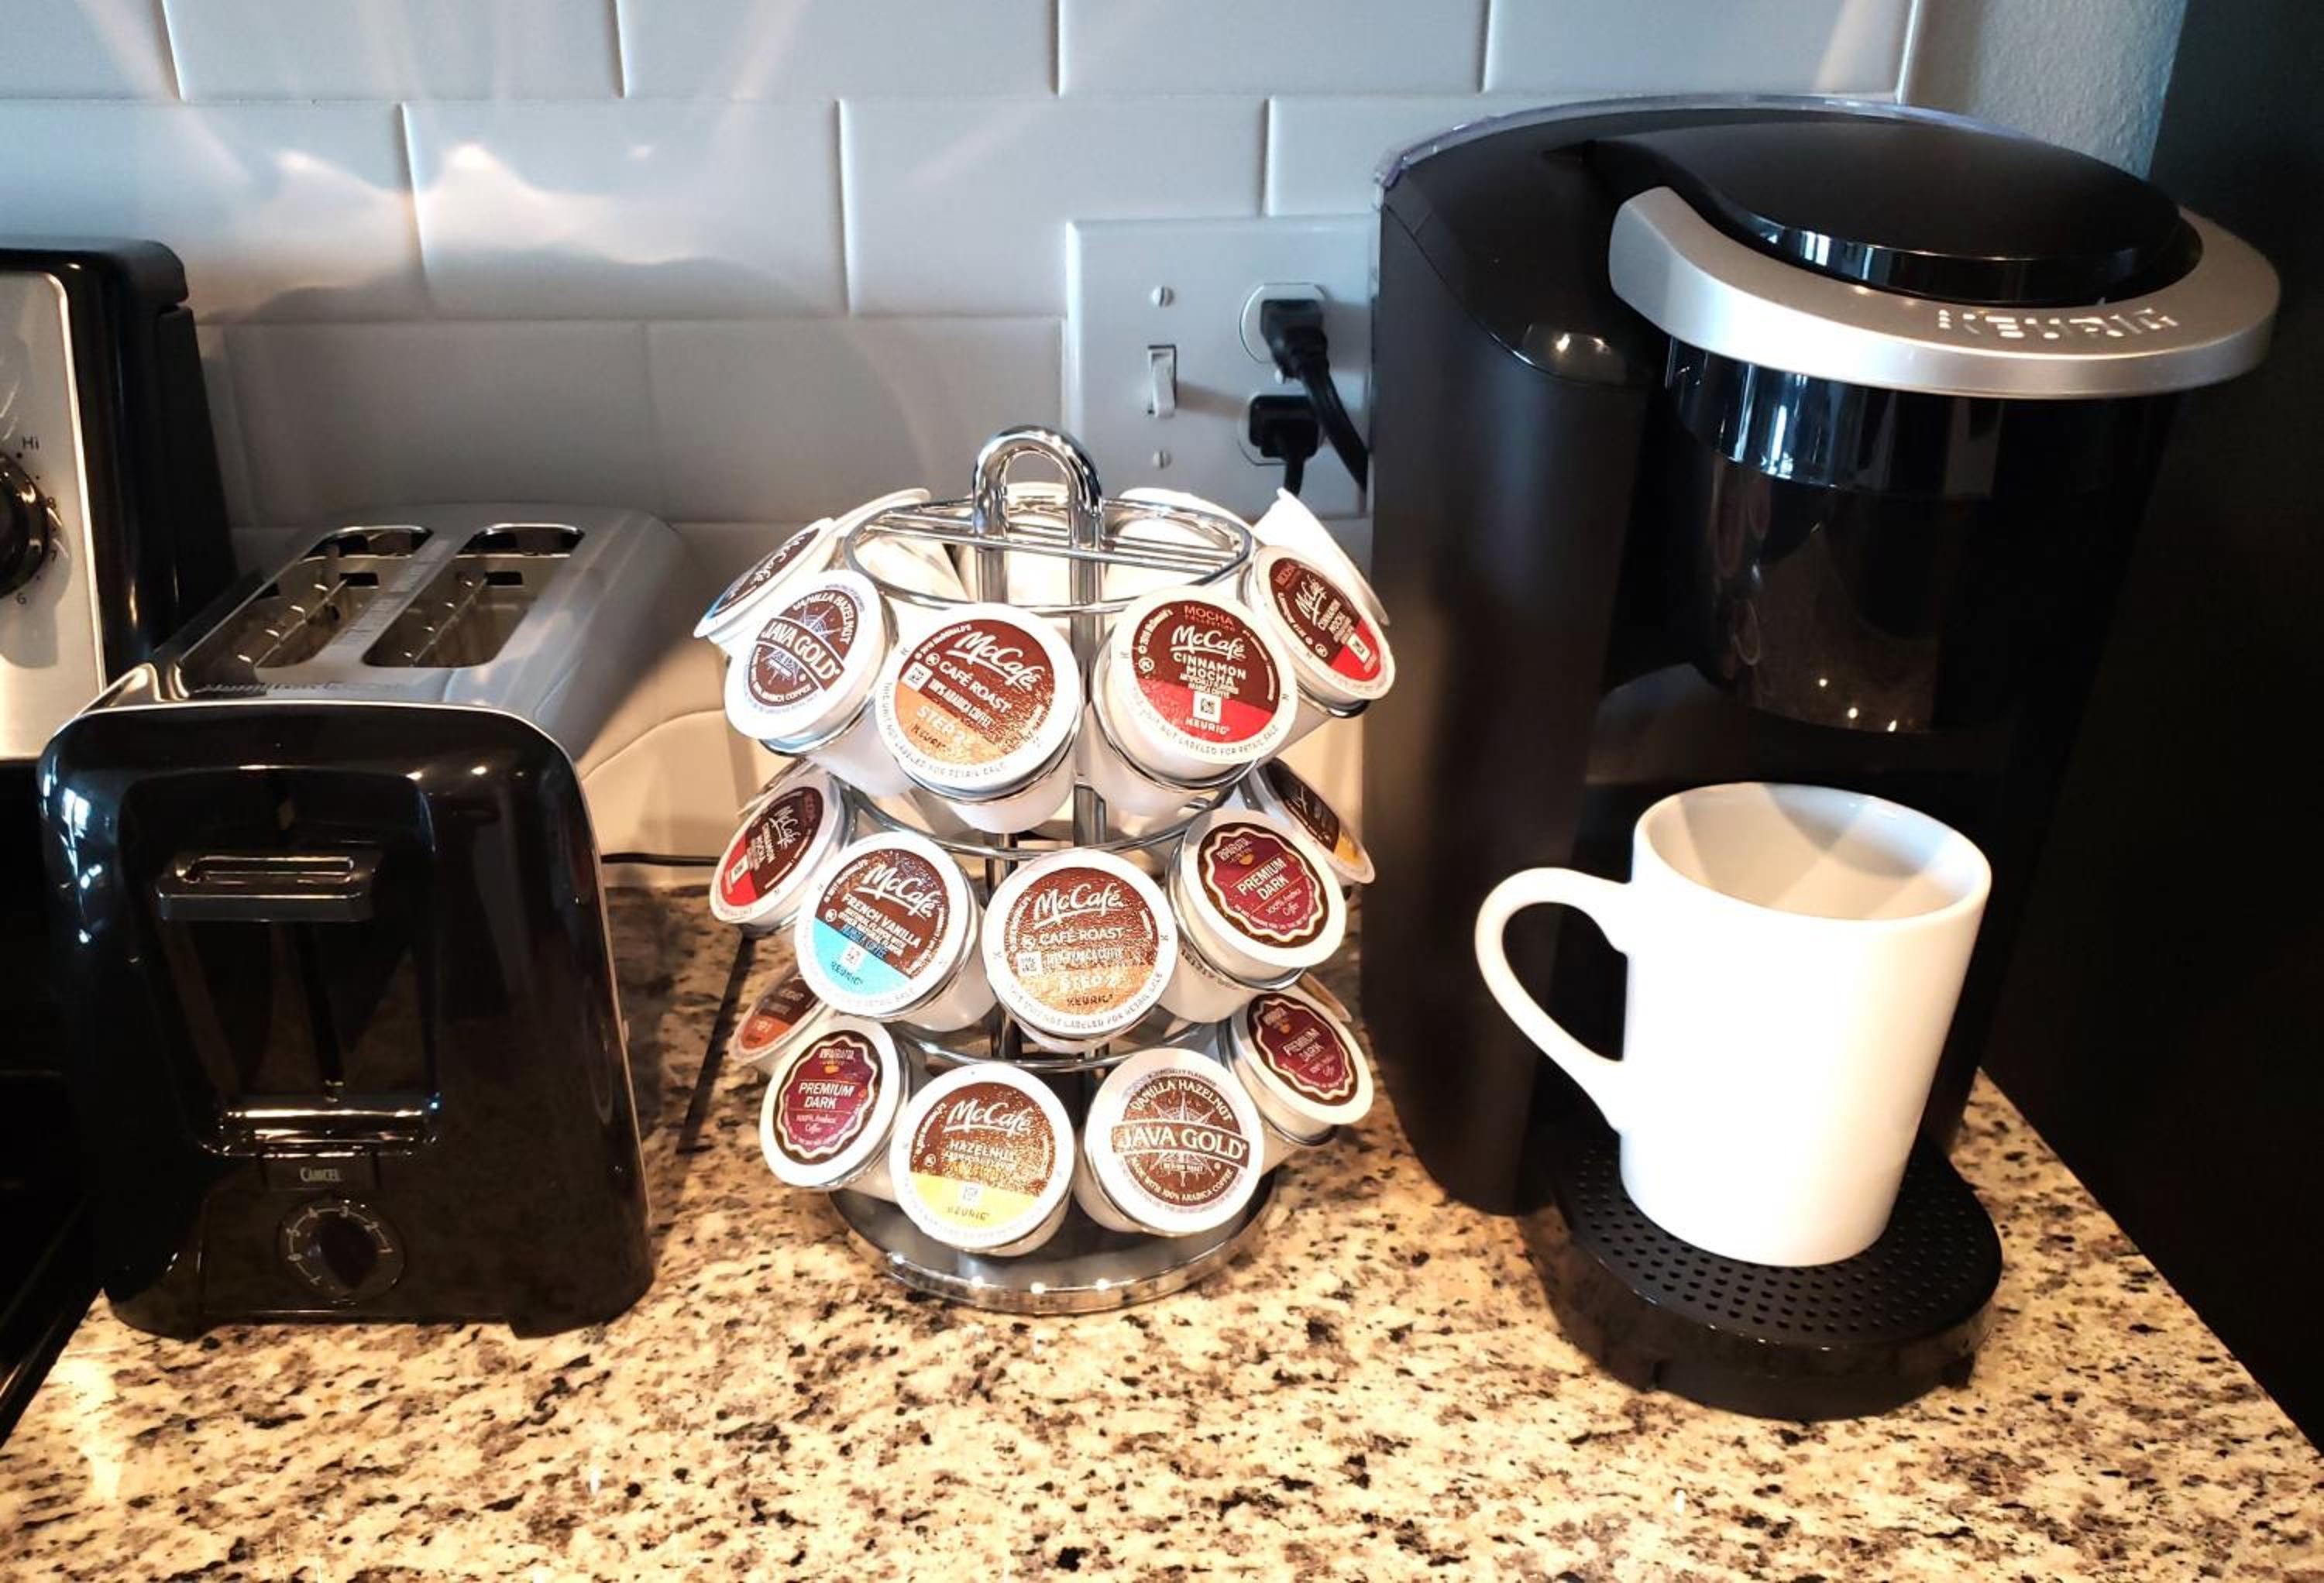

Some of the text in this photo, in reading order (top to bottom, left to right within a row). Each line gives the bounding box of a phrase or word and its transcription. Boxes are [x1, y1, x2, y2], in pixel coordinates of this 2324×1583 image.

[22, 437, 39, 449] Hi
[16, 592, 27, 606] 6
[1184, 605, 1234, 627] MOCHA
[760, 621, 798, 648] JAVA
[794, 635, 837, 679] GOLD
[1171, 625, 1247, 661] McCafé
[946, 631, 1046, 693] McCafé
[1173, 652, 1246, 680] CINNAMON
[1186, 665, 1235, 687] MOCHA
[939, 661, 1013, 713] CAFÉ ROAST
[1185, 717, 1229, 735] KEURIG
[1236, 857, 1287, 896] PREMIUM
[1256, 874, 1290, 901] DARK
[854, 863, 942, 922] McCafé
[1033, 882, 1126, 930] McCafé
[841, 892, 882, 923] FRENCH
[881, 915, 922, 949] VANILLA
[1040, 927, 1124, 945] CAFÉ ROAST
[798, 1082, 855, 1097] PREMIUM
[803, 1096, 837, 1110] DARK
[1177, 1079, 1233, 1122] HAZELNUT
[942, 1097, 1035, 1138] McCafé
[947, 1138, 1016, 1161] HAZELNUT
[1116, 1125, 1244, 1160] JAVA GOLD
[1212, 1168, 1234, 1193] COFFEE
